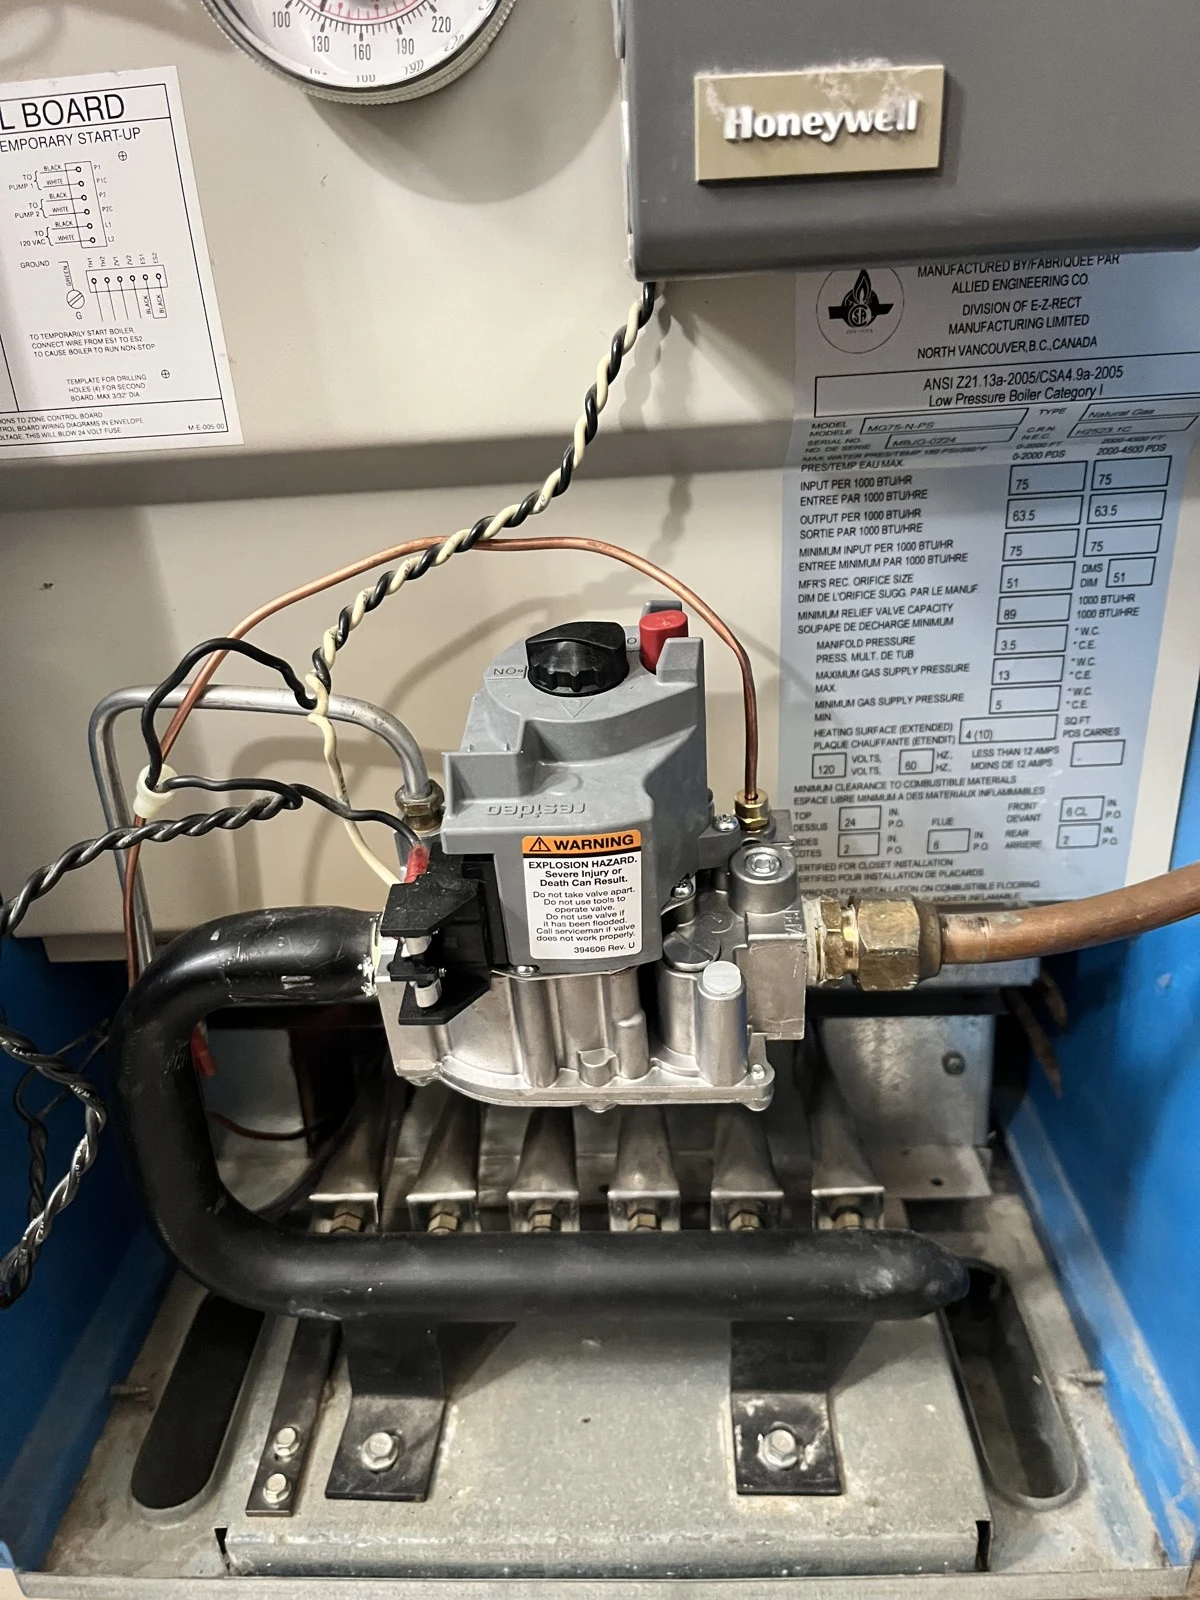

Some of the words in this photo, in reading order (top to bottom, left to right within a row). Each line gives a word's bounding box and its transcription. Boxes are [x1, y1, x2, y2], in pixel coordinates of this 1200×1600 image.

[272, 12, 290, 28] 100
[432, 16, 451, 33] 220
[312, 36, 329, 52] 130
[397, 39, 414, 55] 190
[353, 44, 371, 60] 160
[22, 93, 125, 127] BOARD
[723, 100, 918, 142] Honeywell
[79, 127, 141, 144] START-UP
[21, 260, 49, 268] GROUND
[918, 260, 1010, 277] MANUFACTURED
[1097, 254, 1119, 265] PAR
[952, 281, 989, 293] ALLIED
[992, 274, 1069, 291] ENGINEERING
[963, 303, 1010, 316] DIVISION
[1013, 301, 1028, 312] OF
[1031, 296, 1082, 311] E-Z-RECT
[76, 312, 82, 320] G
[949, 318, 1043, 334] MANUFACTURING
[1046, 314, 1089, 327] LIMITED
[40, 330, 86, 340] TEMPORARILY
[32, 340, 64, 349] CONNECT
[44, 349, 66, 357] CAUSE
[68, 347, 92, 355] BOILER
[917, 346, 956, 359] NORTH
[67, 377, 99, 385] TEMPLATE
[924, 378, 953, 391] ANSI
[69, 385, 91, 393] HOLES
[118, 382, 145, 390] SECOND
[929, 395, 951, 407] Low
[956, 392, 1005, 405] Pressure
[1010, 389, 1041, 401] Boiler
[1045, 387, 1097, 401] Category
[1088, 410, 1129, 418] Natural
[801, 480, 828, 491] INPUT
[832, 478, 850, 489] PER
[854, 477, 875, 488] 1000
[877, 475, 912, 486] BTU/HR
[1016, 479, 1029, 490] 75
[1099, 474, 1112, 485] 75
[800, 513, 838, 524] OUTPUT
[841, 512, 860, 522] PER
[864, 511, 883, 521] 1000
[886, 508, 921, 520] BTU/HR
[1013, 510, 1035, 522] 63.5
[1095, 505, 1118, 517] 63.5
[1010, 545, 1022, 556] 75
[1091, 541, 1103, 552] 75
[1007, 578, 1018, 588] 51
[1114, 572, 1125, 583] 51
[1004, 609, 1016, 620] 89
[817, 639, 863, 650] MANIFOLD
[866, 636, 915, 647] PRESSURE
[1001, 641, 1016, 651] 3.5
[816, 669, 859, 680] MAXIMUM
[862, 668, 880, 678] GAS
[883, 666, 918, 676] SUPPLY
[921, 663, 970, 674] PRESSURE
[999, 671, 1010, 680] 13
[815, 699, 855, 709] MINIMUM
[857, 698, 875, 707] GAS
[878, 696, 912, 706] SUPPLY
[915, 693, 964, 703] PRESSURE
[996, 700, 1001, 710] 5
[814, 727, 853, 737] HEATING
[855, 725, 896, 736] SURFACE
[900, 723, 952, 734] (EXTENDED)
[966, 731, 971, 739] 4
[974, 729, 993, 740] (10)
[818, 765, 835, 774] 120
[905, 761, 916, 770] 60
[488, 803, 585, 817] resideo
[845, 818, 855, 827] 24
[554, 835, 633, 851] WARNING
[592, 856, 637, 868] HAZARD.
[545, 870, 578, 878] Severe
[582, 869, 609, 877] Injury
[595, 876, 628, 885] Result.
[565, 890, 583, 898] take
[586, 889, 608, 897] valve
[611, 887, 635, 896] apart.
[594, 897, 614, 905] tools
[595, 911, 617, 919] valve
[593, 917, 627, 926] flooded.
[613, 923, 635, 932] valve
[600, 931, 635, 942] properly.
